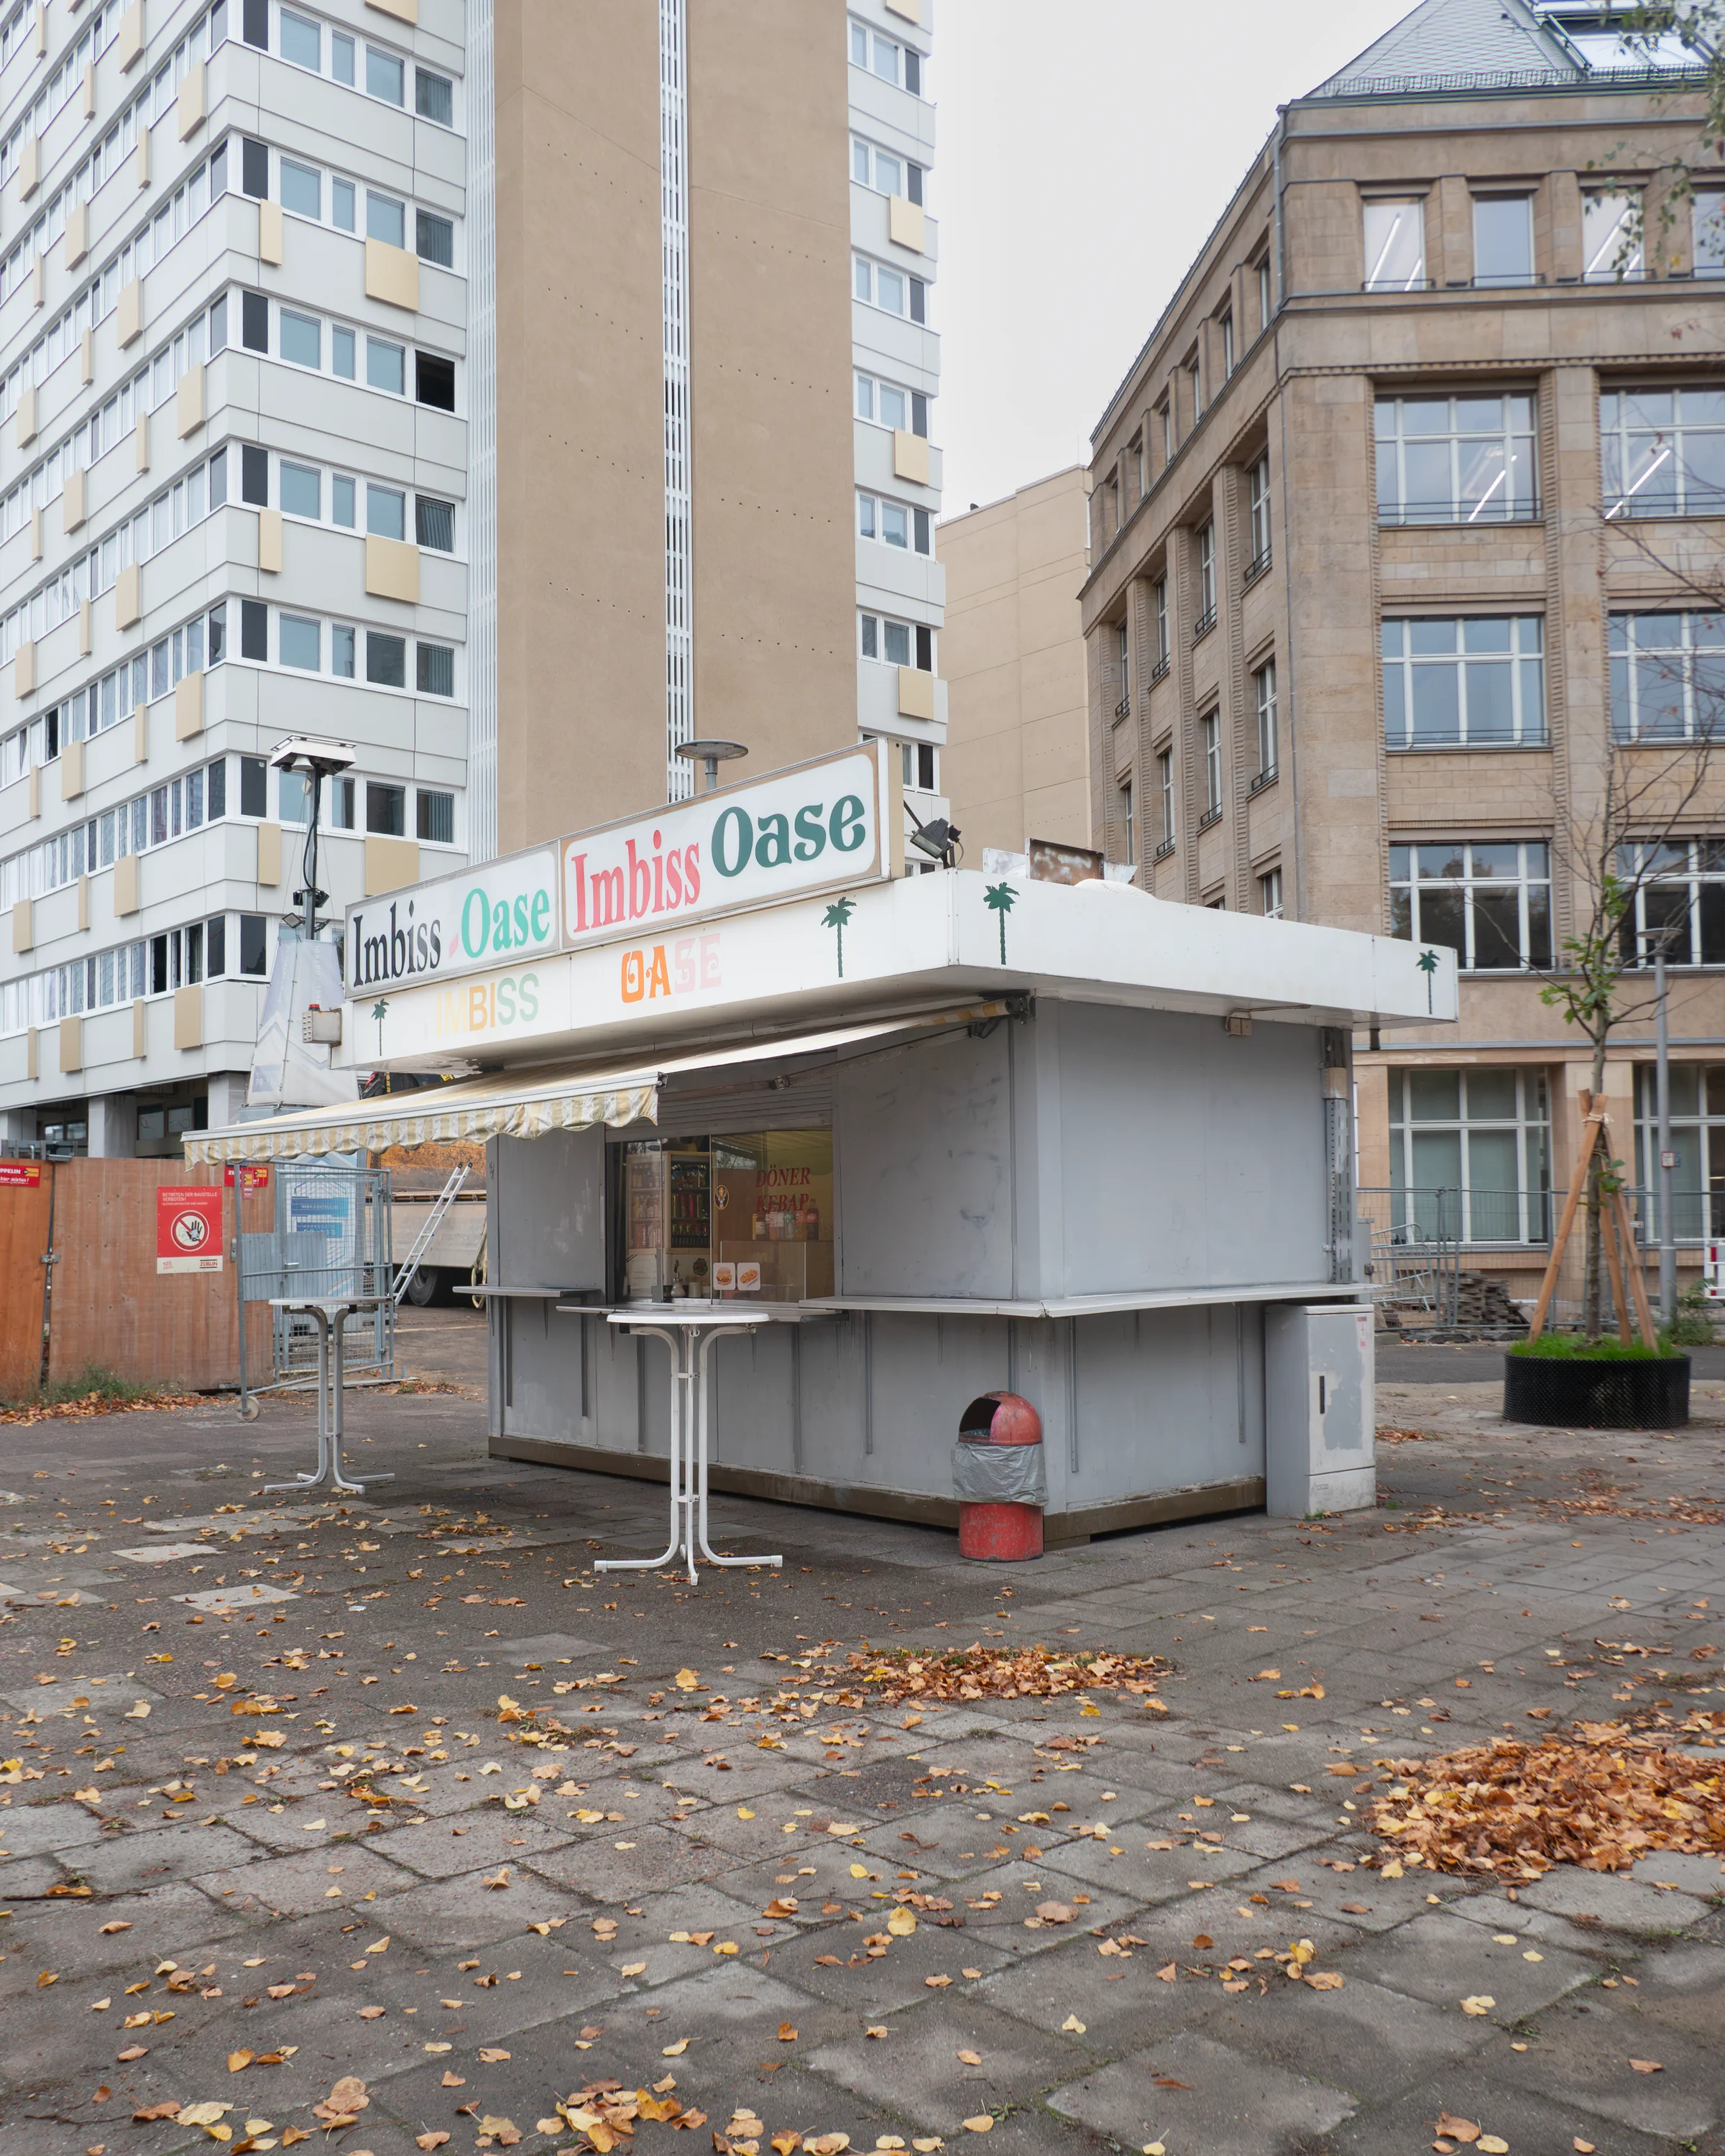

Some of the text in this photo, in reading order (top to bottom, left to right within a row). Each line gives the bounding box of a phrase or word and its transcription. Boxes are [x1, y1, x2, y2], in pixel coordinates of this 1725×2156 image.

[571, 794, 866, 934] Imbiss Oase
[353, 900, 441, 987] Imbiss
[436, 934, 721, 1037] IMBISS OASE
[755, 1164, 811, 1188] DÖNER
[757, 1193, 810, 1214] KEBAP
